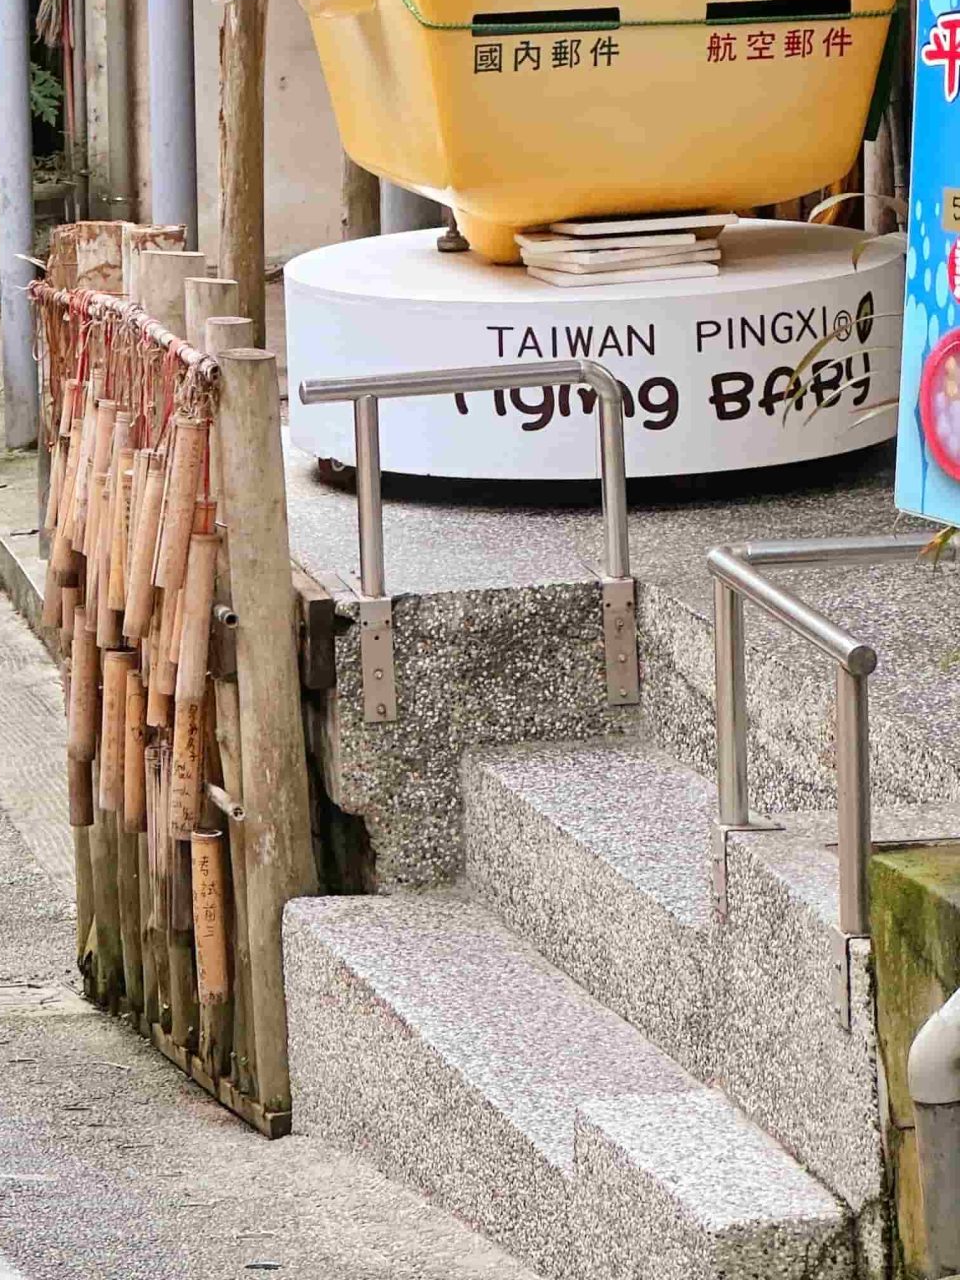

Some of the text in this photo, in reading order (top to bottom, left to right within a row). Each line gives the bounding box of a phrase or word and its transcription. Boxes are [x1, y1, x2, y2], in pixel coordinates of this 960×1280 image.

[473, 36, 620, 74] 國內郵件
[706, 26, 853, 63] 航空郵件
[487, 324, 655, 358] TAIWAN
